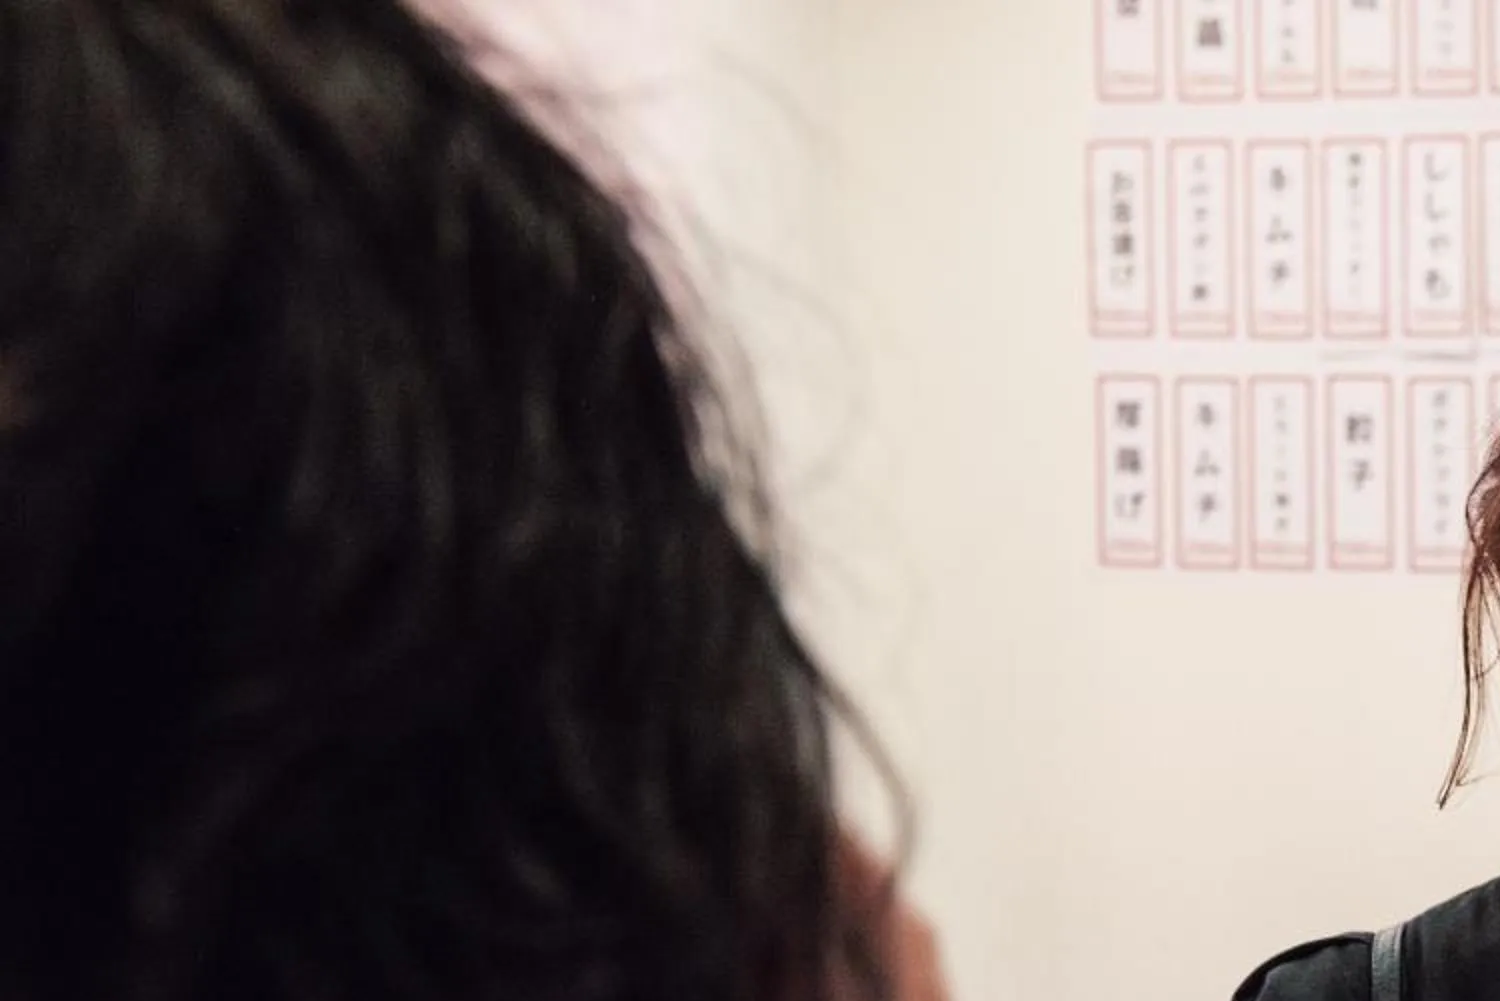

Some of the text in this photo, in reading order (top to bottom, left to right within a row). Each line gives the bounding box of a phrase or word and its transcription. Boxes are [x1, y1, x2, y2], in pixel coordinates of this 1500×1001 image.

[1265, 166, 1293, 286] キムチ
[1424, 154, 1451, 301] ししゃも
[1194, 401, 1222, 522] キムチ
[1344, 412, 1376, 492] 餃子
